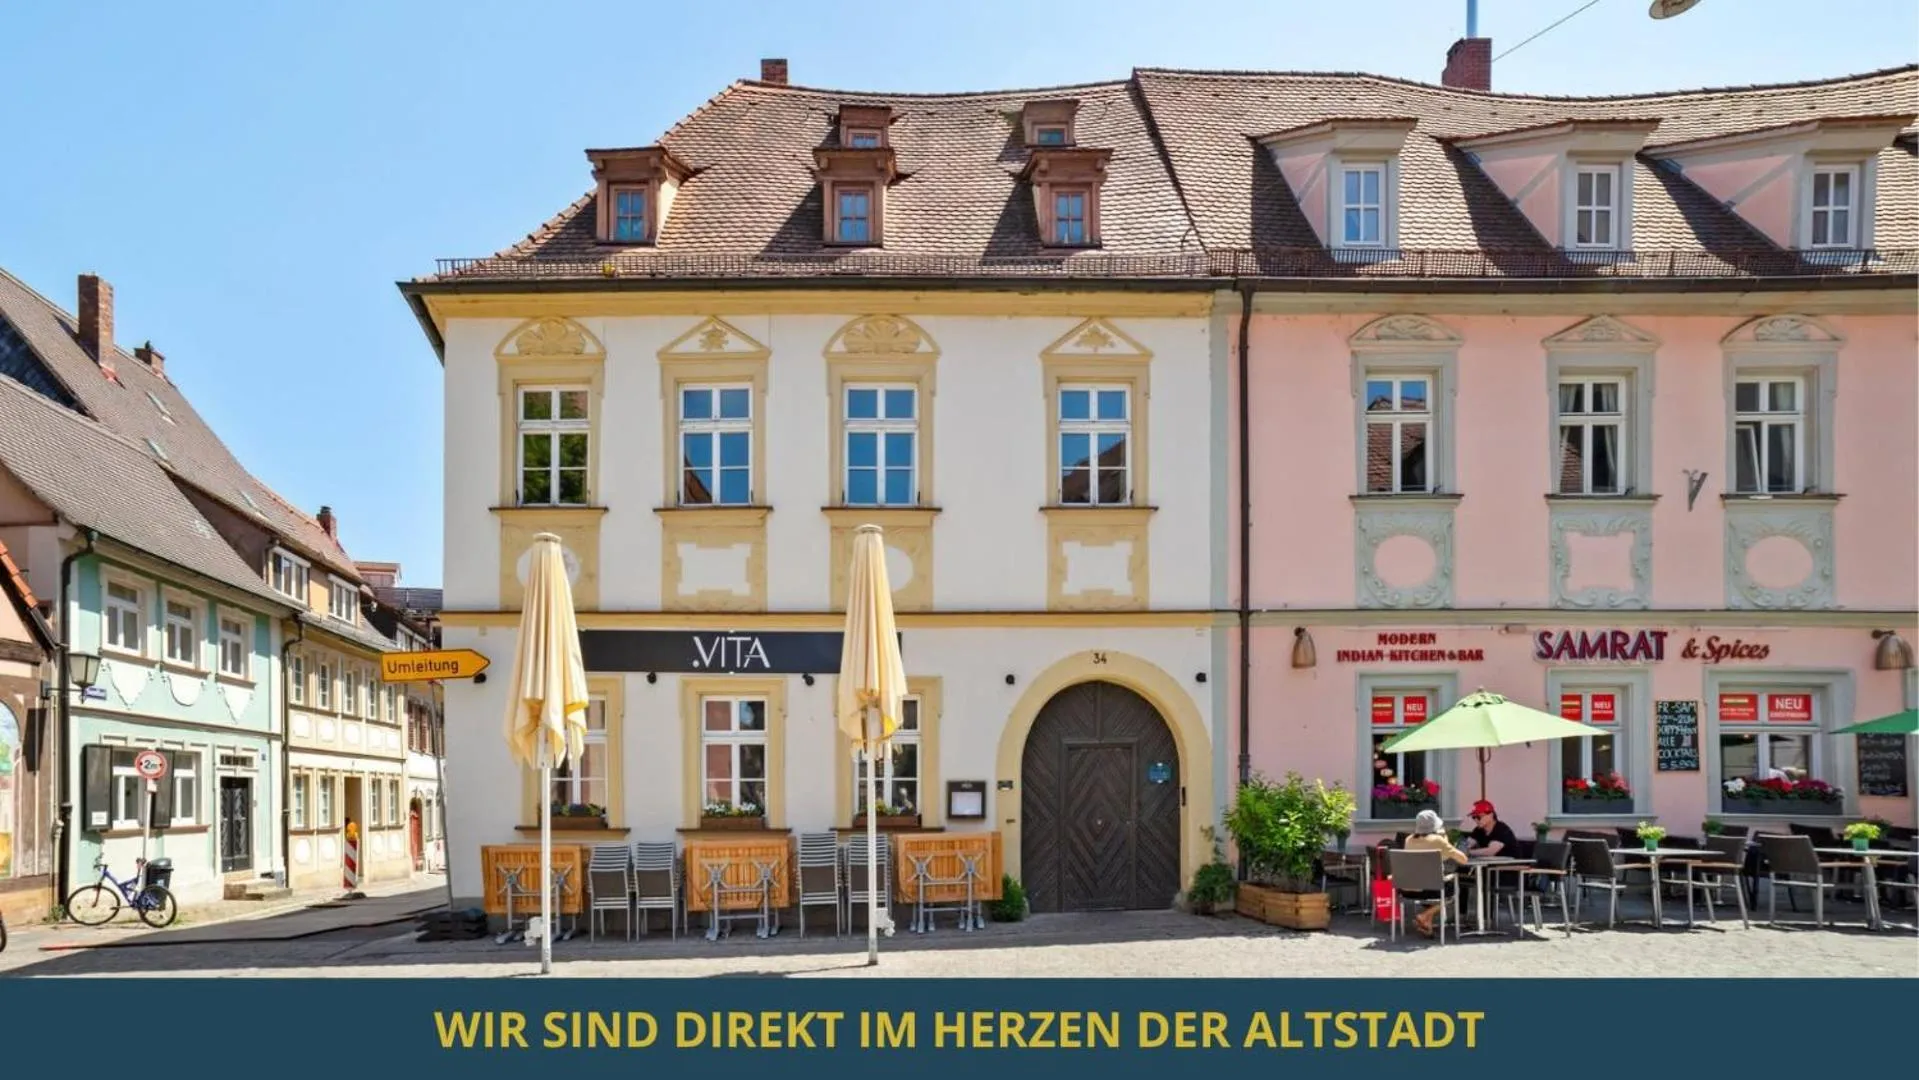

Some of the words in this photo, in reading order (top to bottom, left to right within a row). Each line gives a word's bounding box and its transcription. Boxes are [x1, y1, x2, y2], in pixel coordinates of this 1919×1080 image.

[1377, 632, 1437, 645] MODERN
[1535, 629, 1668, 660] SAMRAT
[1681, 638, 1700, 659] &
[1701, 635, 1771, 663] Spices
[1092, 652, 1107, 665] 34
[387, 659, 459, 674] Umleitung
[1406, 703, 1423, 712] NEU
[1594, 701, 1611, 710] NEU
[1775, 697, 1803, 709] NEU
